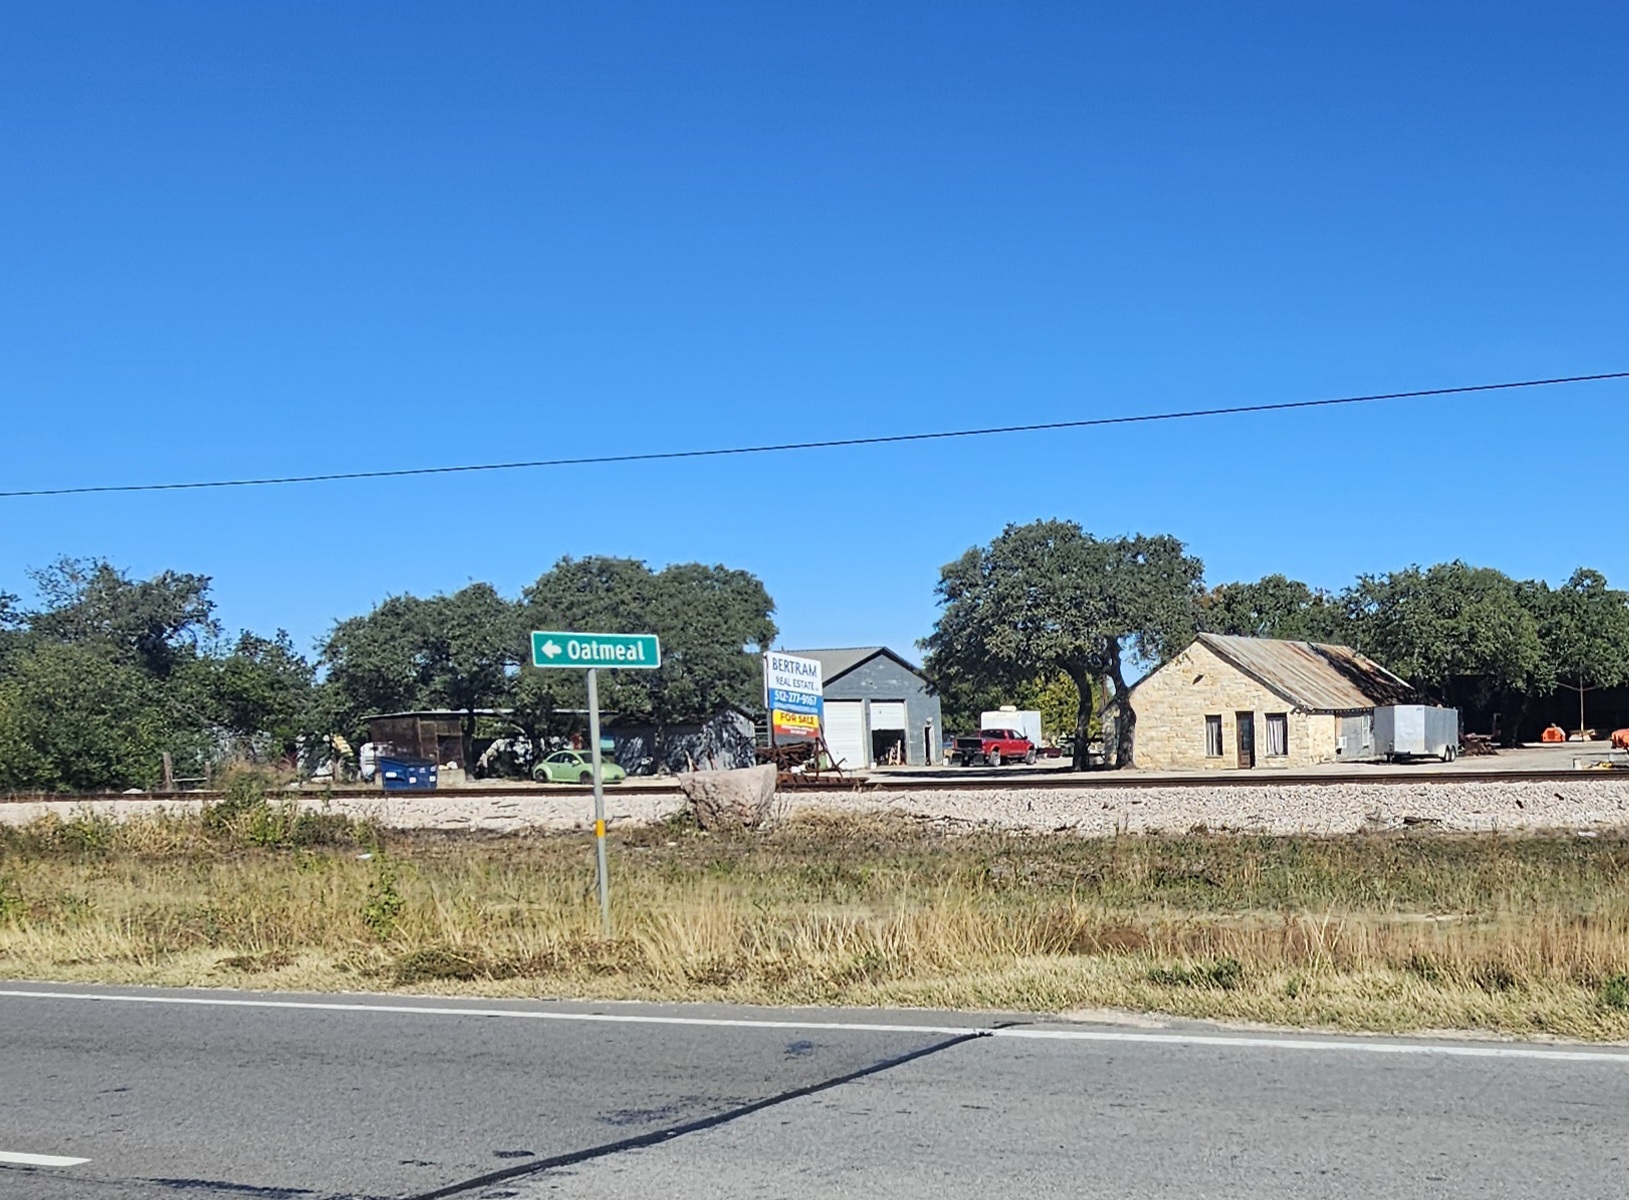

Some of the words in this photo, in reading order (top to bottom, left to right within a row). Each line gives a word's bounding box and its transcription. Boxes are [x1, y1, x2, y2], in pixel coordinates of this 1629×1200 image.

[567, 640, 645, 660] Oatmeal
[772, 657, 817, 677] BERTRAM
[776, 676, 791, 687] REAL
[793, 679, 815, 691] ESTATE
[780, 713, 796, 723] FOR
[798, 714, 815, 725] SALE
